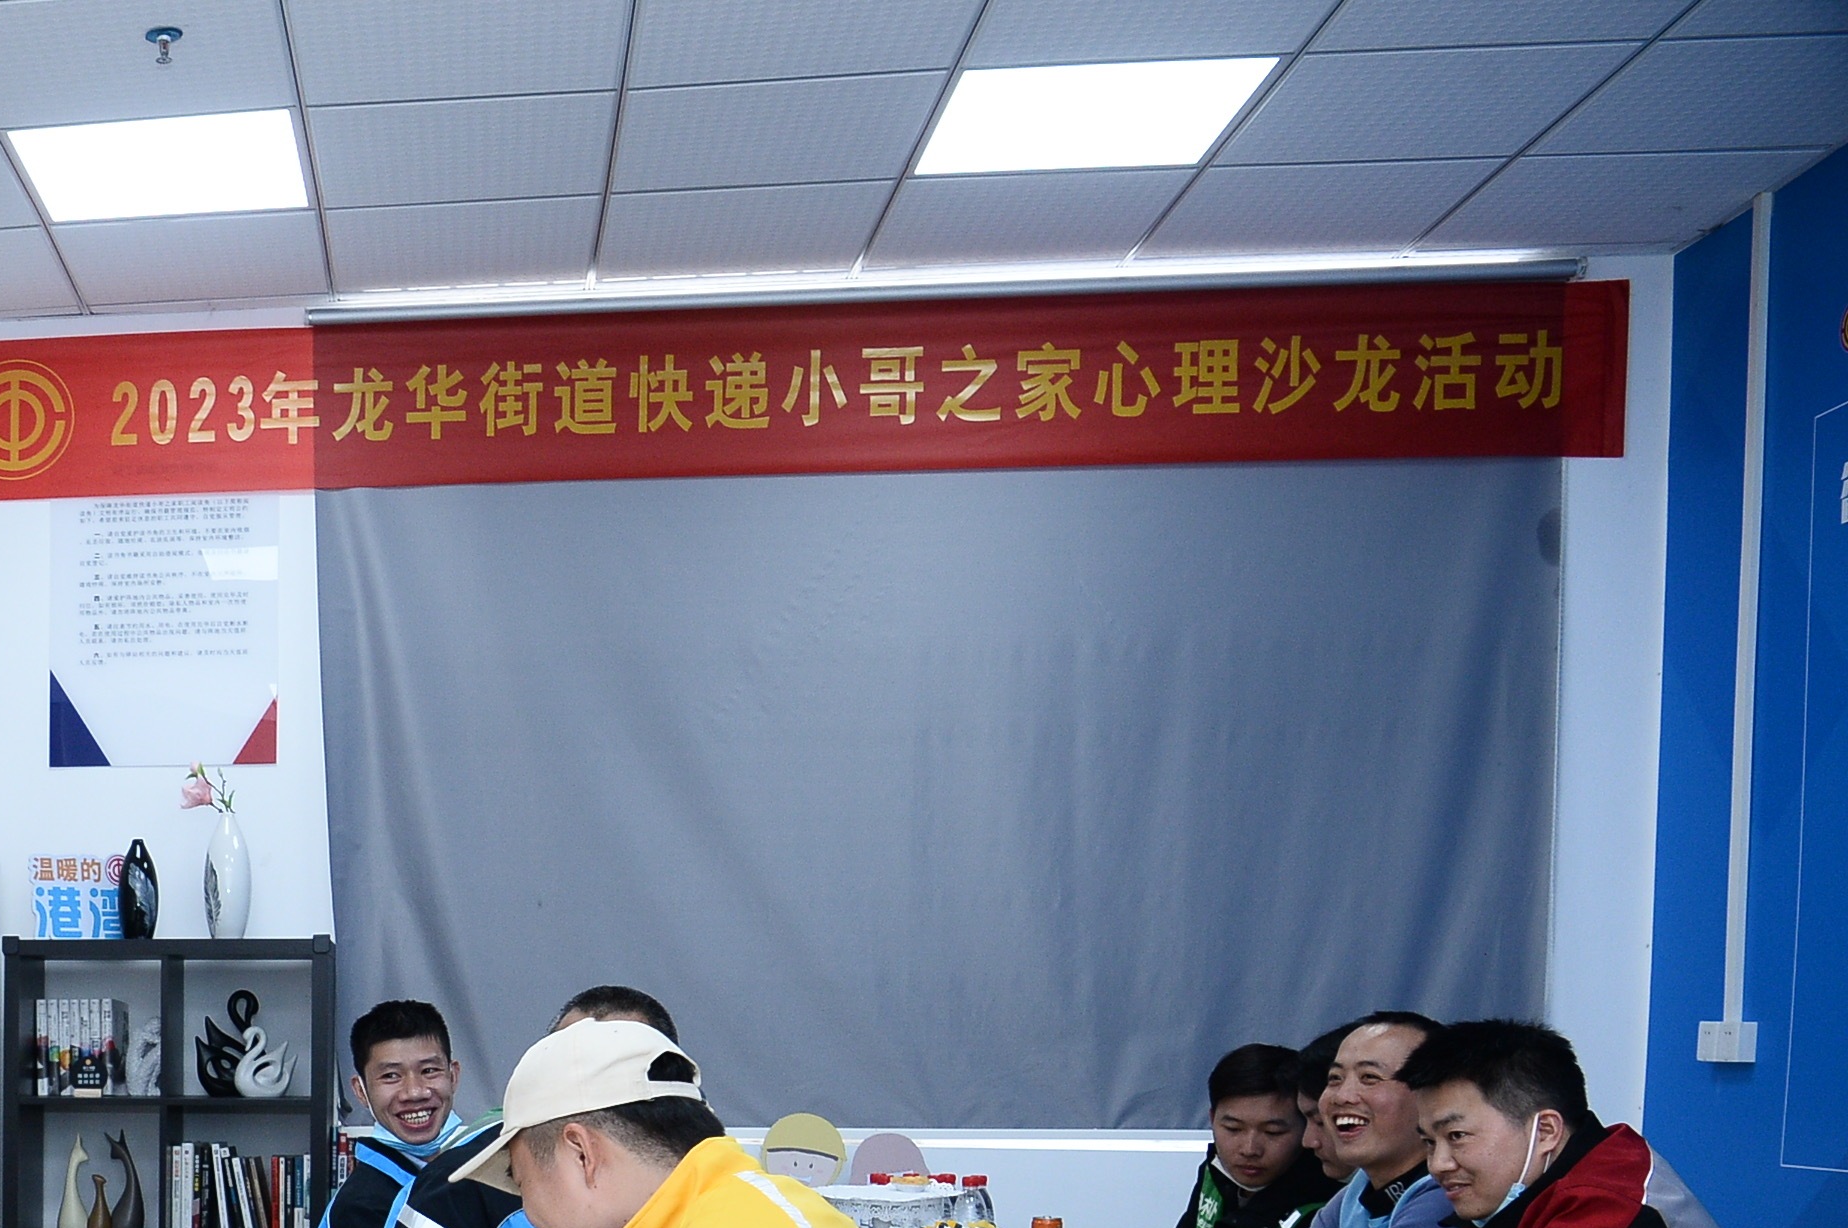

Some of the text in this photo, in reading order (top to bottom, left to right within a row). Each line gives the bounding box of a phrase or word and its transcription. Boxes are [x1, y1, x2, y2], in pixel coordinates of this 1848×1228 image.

[109, 333, 1567, 449] 2023年龙华街道快递小哥之家心理沙龙活动
[33, 857, 102, 883] 温暖的
